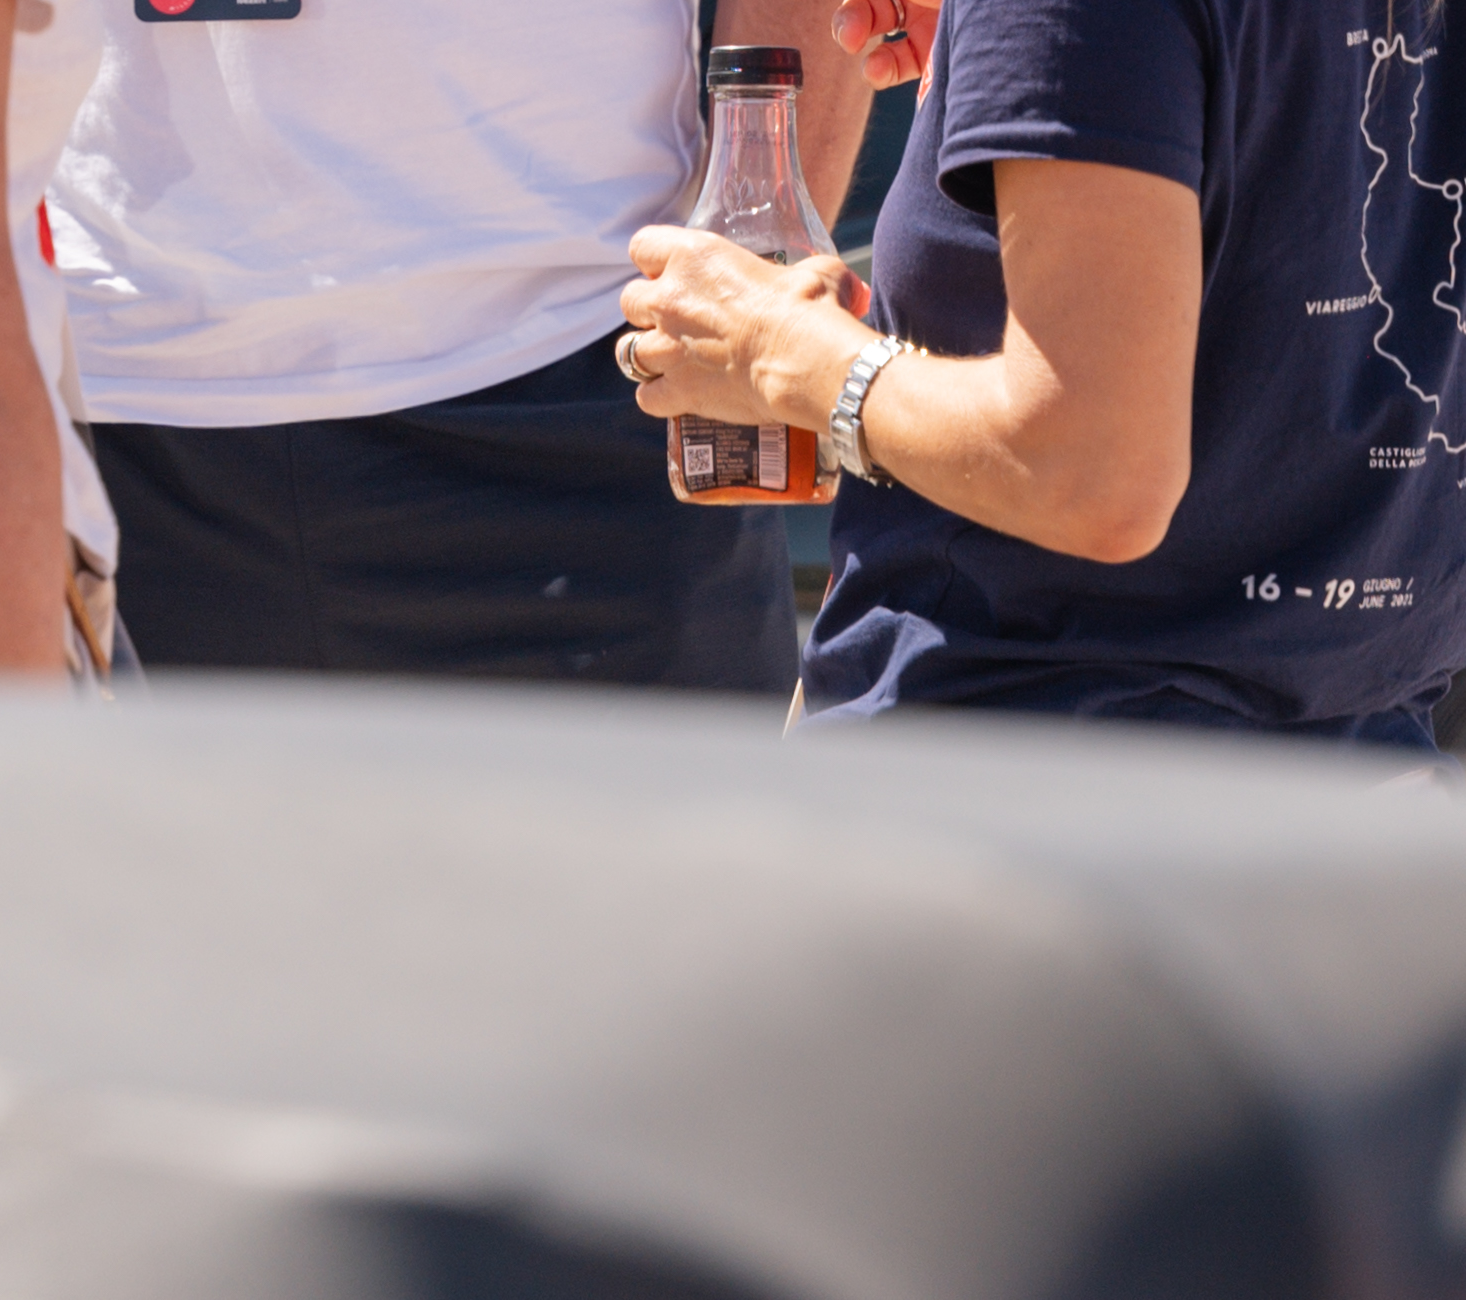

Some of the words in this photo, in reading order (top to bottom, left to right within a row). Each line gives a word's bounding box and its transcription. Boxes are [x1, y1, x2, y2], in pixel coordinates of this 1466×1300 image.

[1305, 295, 1368, 316] VIAREGGIO
[1369, 458, 1407, 469] DELLA
[1241, 573, 1281, 601] 16
[1323, 578, 1356, 610] 19
[1362, 577, 1402, 593] GIUGNO
[1358, 594, 1386, 610] JUNE
